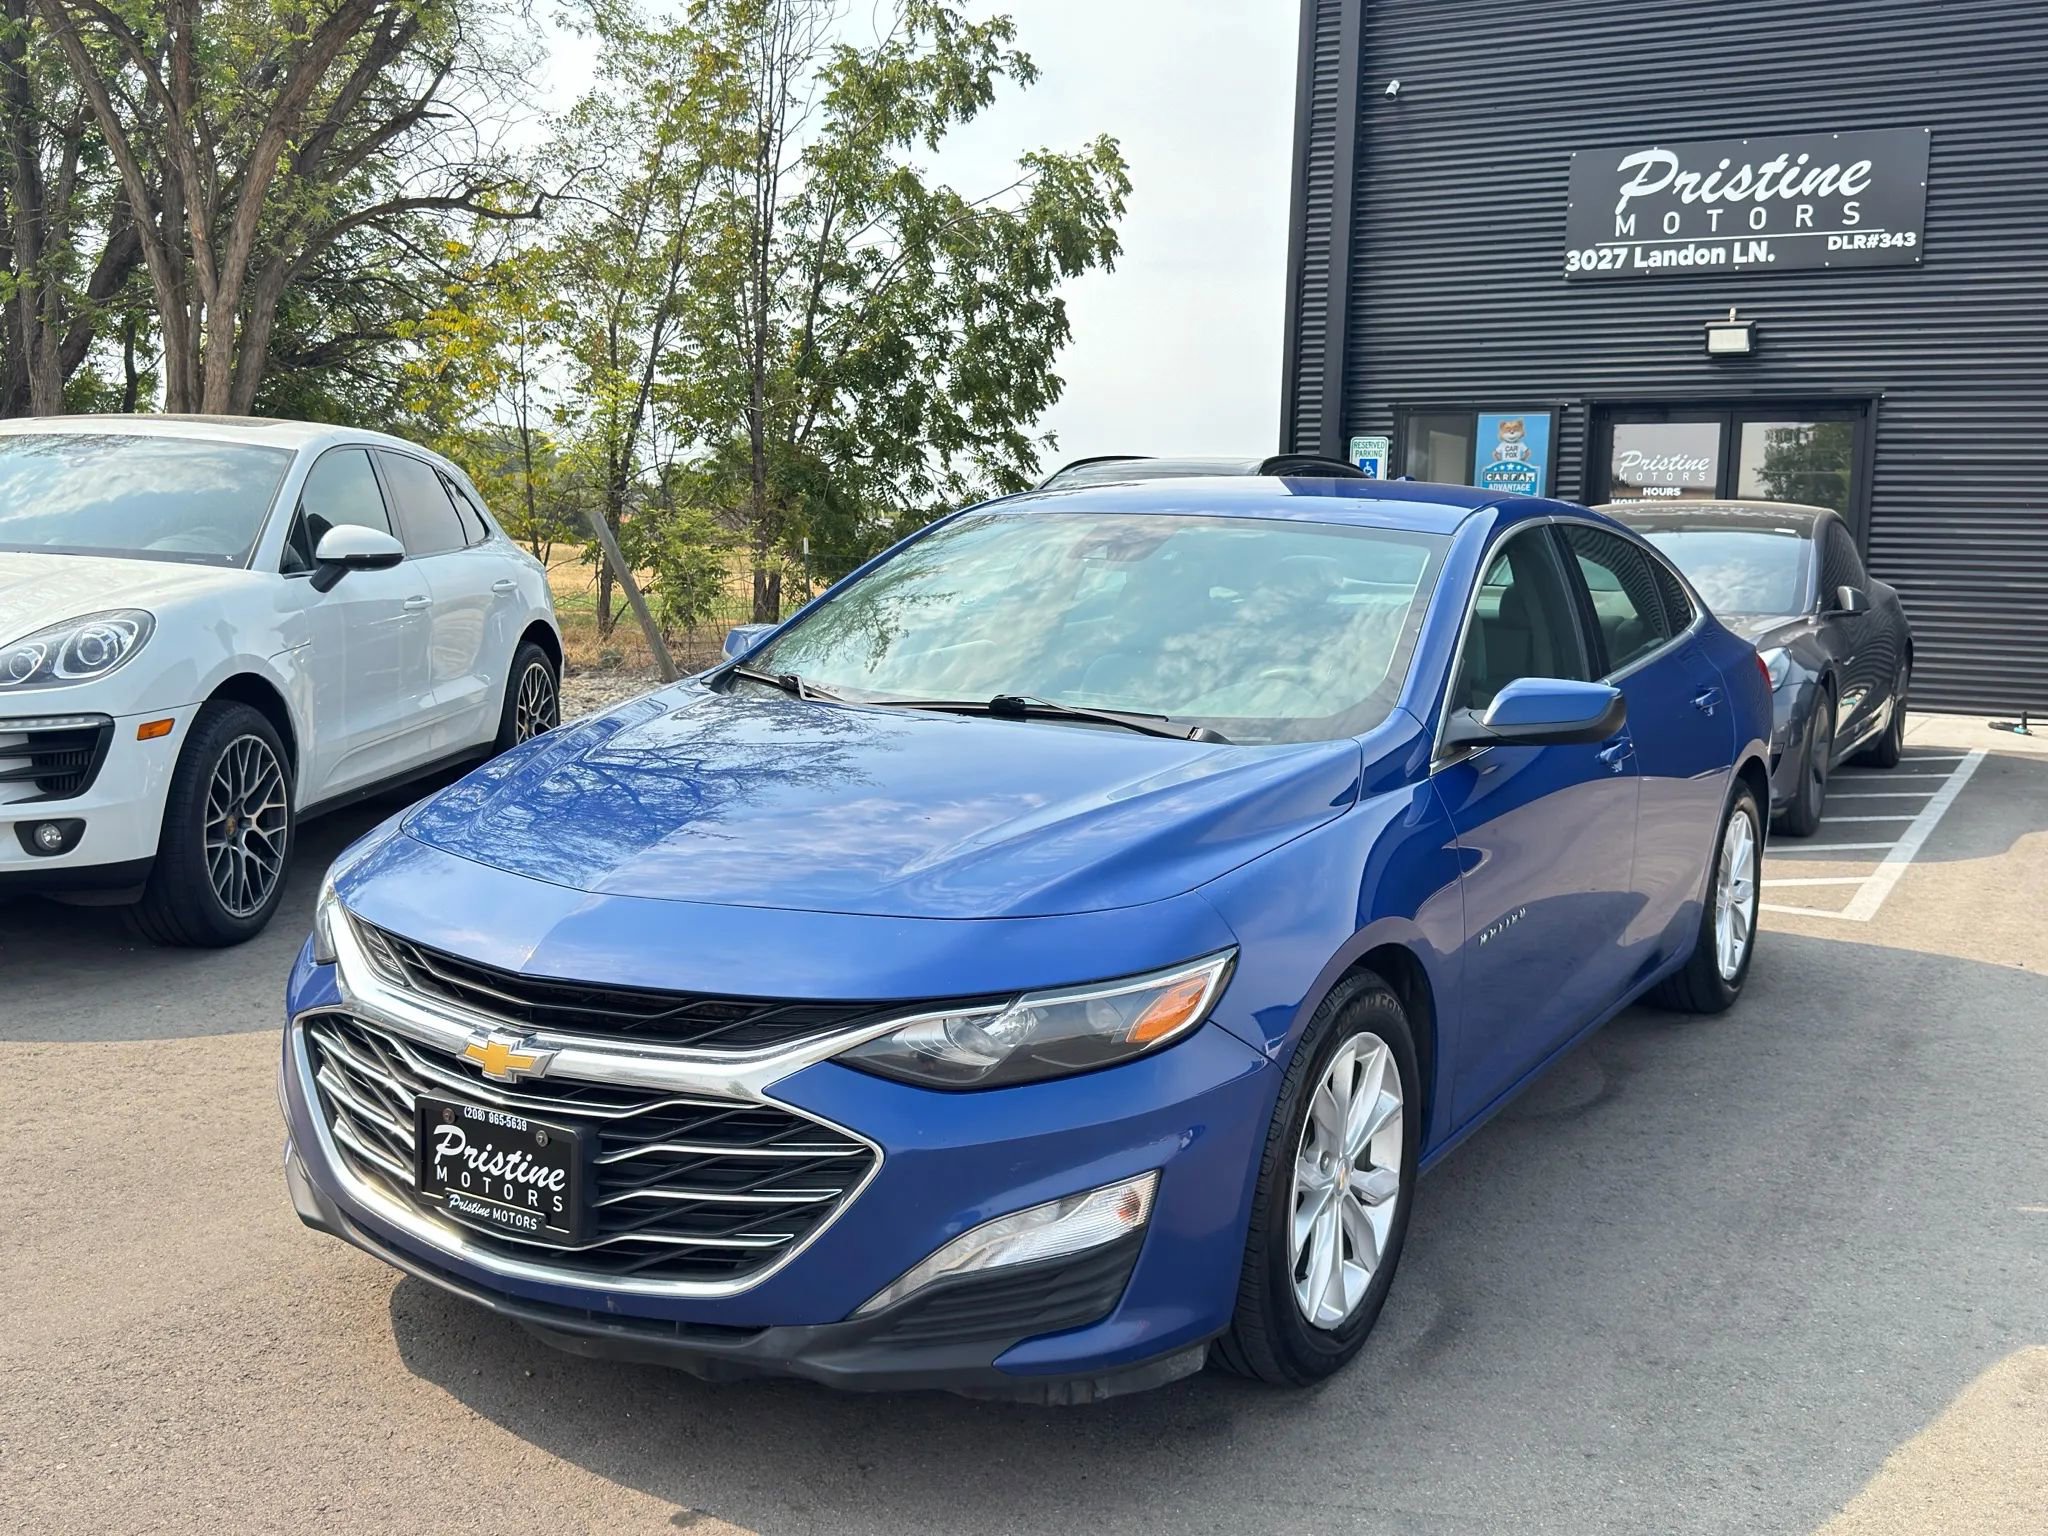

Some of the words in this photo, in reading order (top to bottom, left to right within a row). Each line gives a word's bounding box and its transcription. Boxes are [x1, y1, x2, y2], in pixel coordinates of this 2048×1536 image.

[1617, 149, 1872, 215] Pristine
[1615, 202, 1861, 237] MOTORS
[1827, 232, 1917, 251] DLR#343
[1565, 248, 1628, 272] 3027
[1634, 245, 1726, 268] Landon
[1732, 241, 1776, 265] LN.
[1353, 441, 1385, 450] RESERVED
[1355, 450, 1383, 458] PARKING
[1619, 450, 1710, 473] Pristine
[1486, 473, 1535, 482] CARFAX
[1619, 472, 1706, 481] MOTORS
[1488, 483, 1531, 492] ADVANTAGE
[1642, 487, 1682, 496] HOURS
[463, 1106, 486, 1122] (208)
[433, 1124, 566, 1192] Pristine
[436, 1164, 563, 1212] MOTORS
[449, 1193, 490, 1217] Pristine
[492, 1207, 537, 1230] MOTORS
